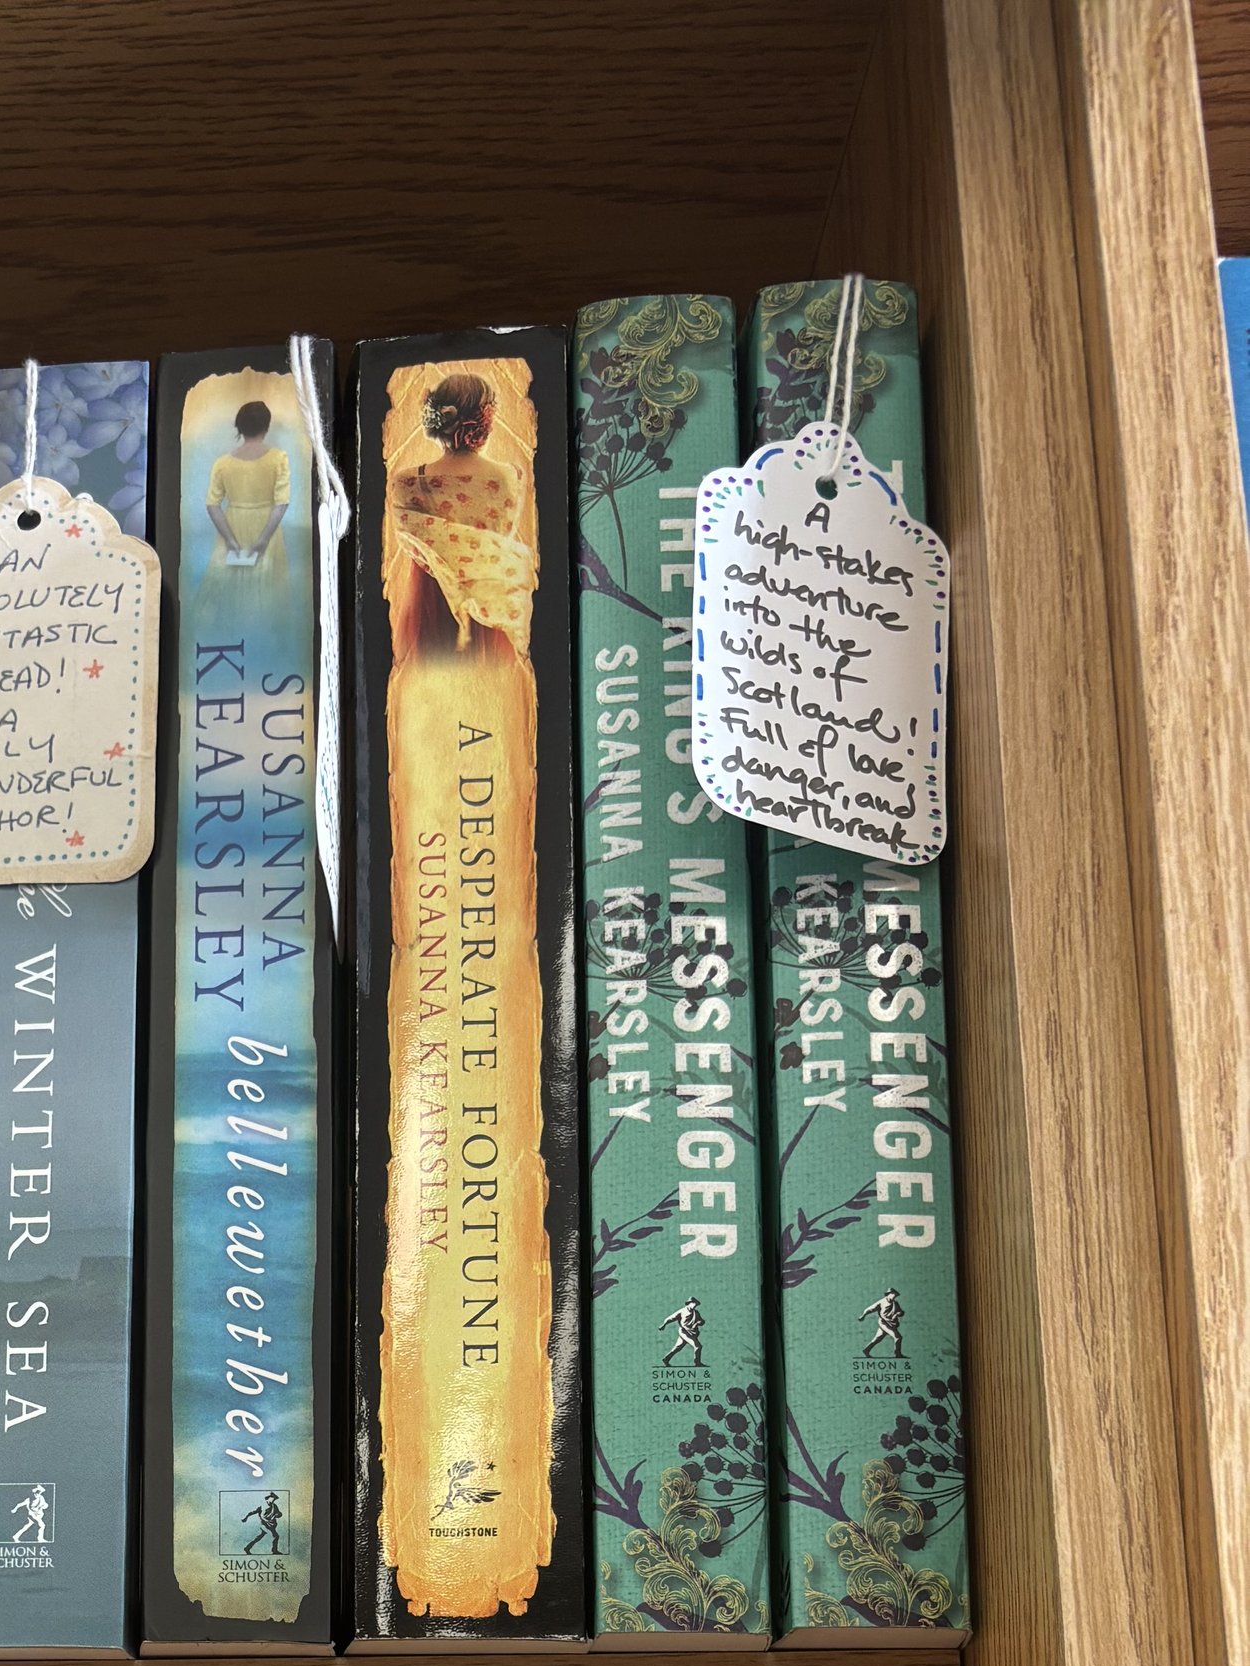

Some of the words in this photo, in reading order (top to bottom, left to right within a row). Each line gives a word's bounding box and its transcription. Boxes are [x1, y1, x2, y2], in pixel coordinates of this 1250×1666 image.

[734, 511, 914, 596] high-stakes
[805, 502, 829, 532] A
[724, 586, 780, 627] into
[790, 616, 871, 657] the
[725, 565, 909, 630] adventure
[814, 655, 867, 700] of
[458, 721, 493, 750] A
[595, 644, 644, 862] SUSANNA
[720, 706, 788, 750] Full
[799, 725, 838, 776] of
[194, 638, 245, 1012] KEARSLEY
[261, 672, 306, 972] SUSANNA
[736, 780, 919, 852] heartbreak
[418, 831, 447, 1023] SUSANNA
[458, 775, 498, 1073] DESPERATE
[668, 858, 738, 1263] MESSENGER
[8, 943, 57, 1262] WINTER
[418, 1041, 450, 1254] KEARSLEY
[225, 1035, 289, 1478] bellewether
[461, 1102, 500, 1367] FORTUNE
[5, 1300, 48, 1433] SEA
[653, 1395, 711, 1403] CANADA
[854, 1386, 912, 1394] CANADA
[223, 1559, 270, 1570] SIMON
[429, 1527, 498, 1537] TOUCHSTONE
[218, 1572, 290, 1582] SCHUSTER
